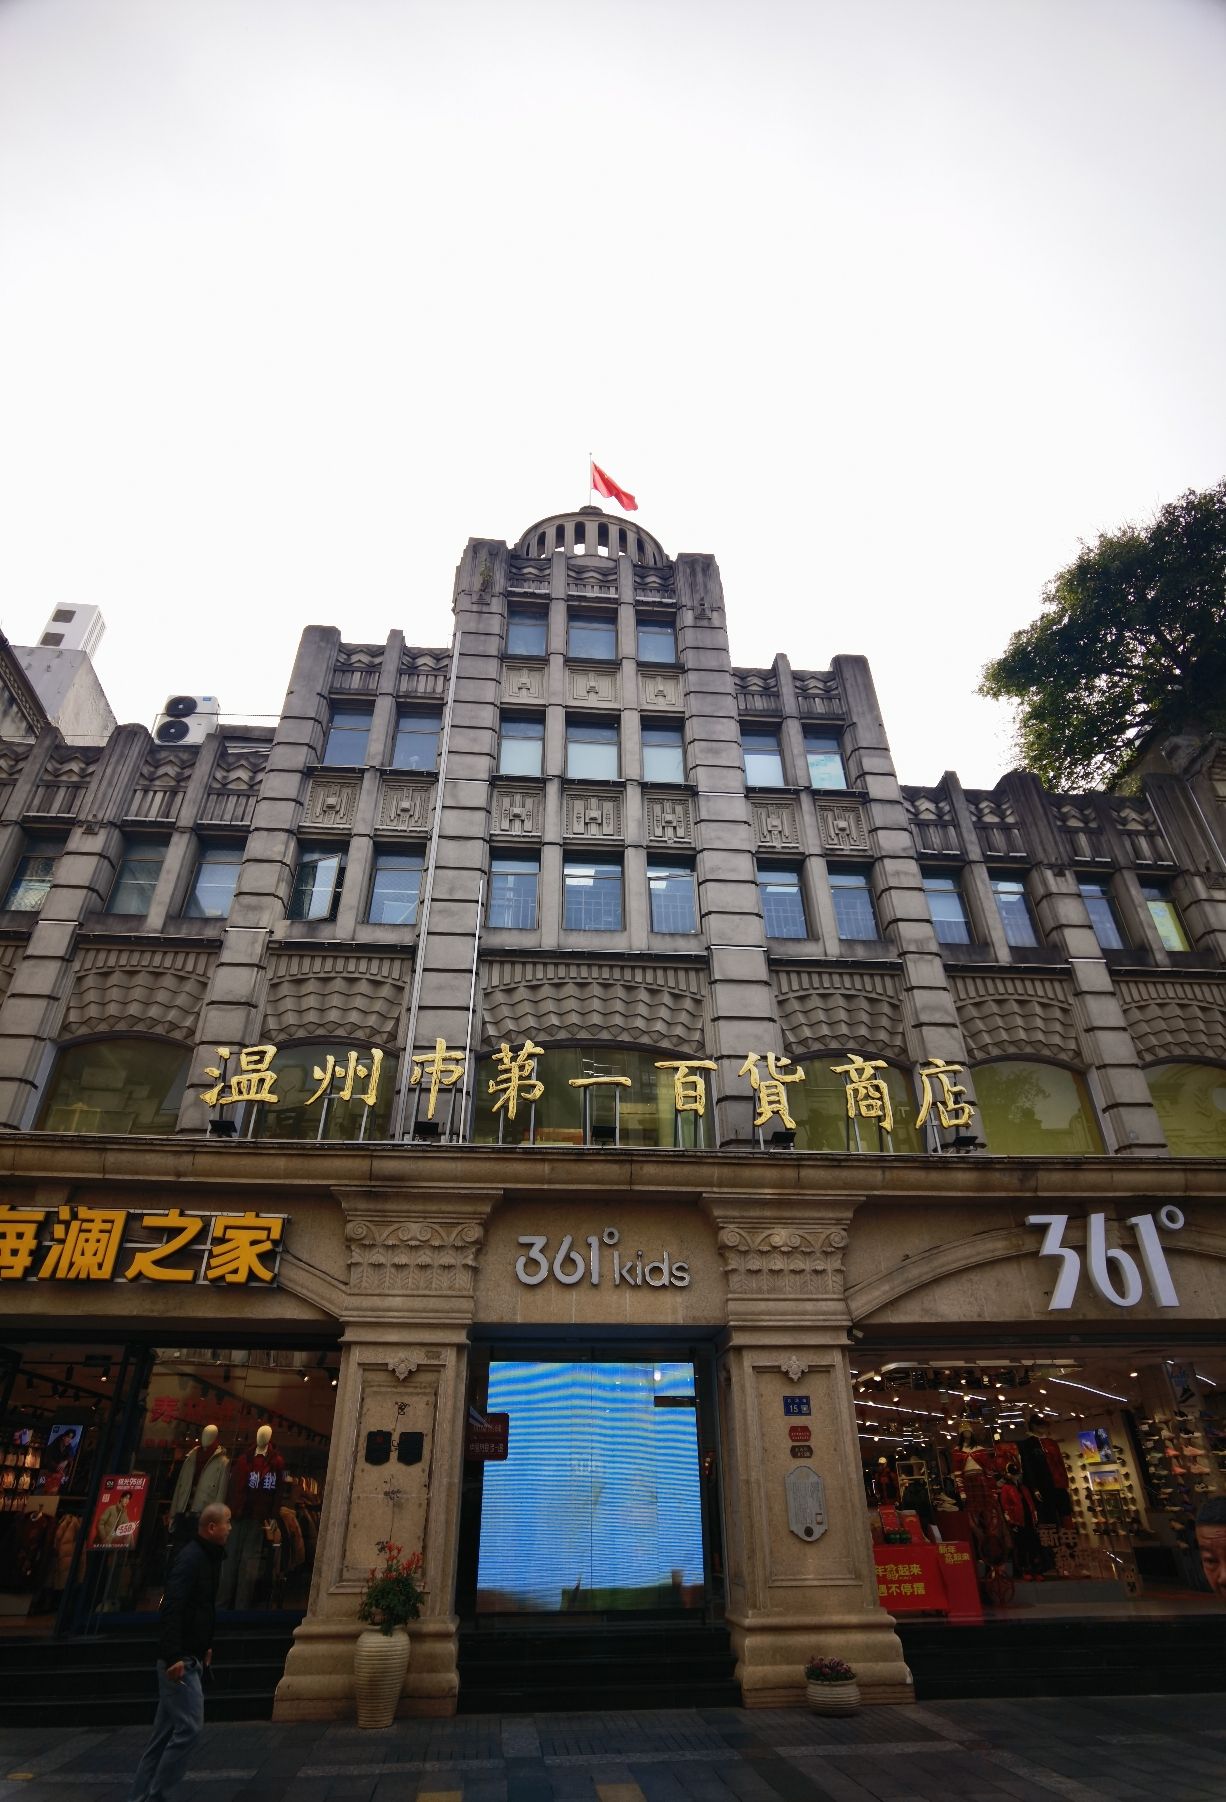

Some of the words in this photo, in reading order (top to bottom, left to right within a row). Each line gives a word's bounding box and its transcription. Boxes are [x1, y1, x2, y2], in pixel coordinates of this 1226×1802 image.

[0, 1204, 286, 1285] 海澜之家
[613, 1250, 690, 1287] kids
